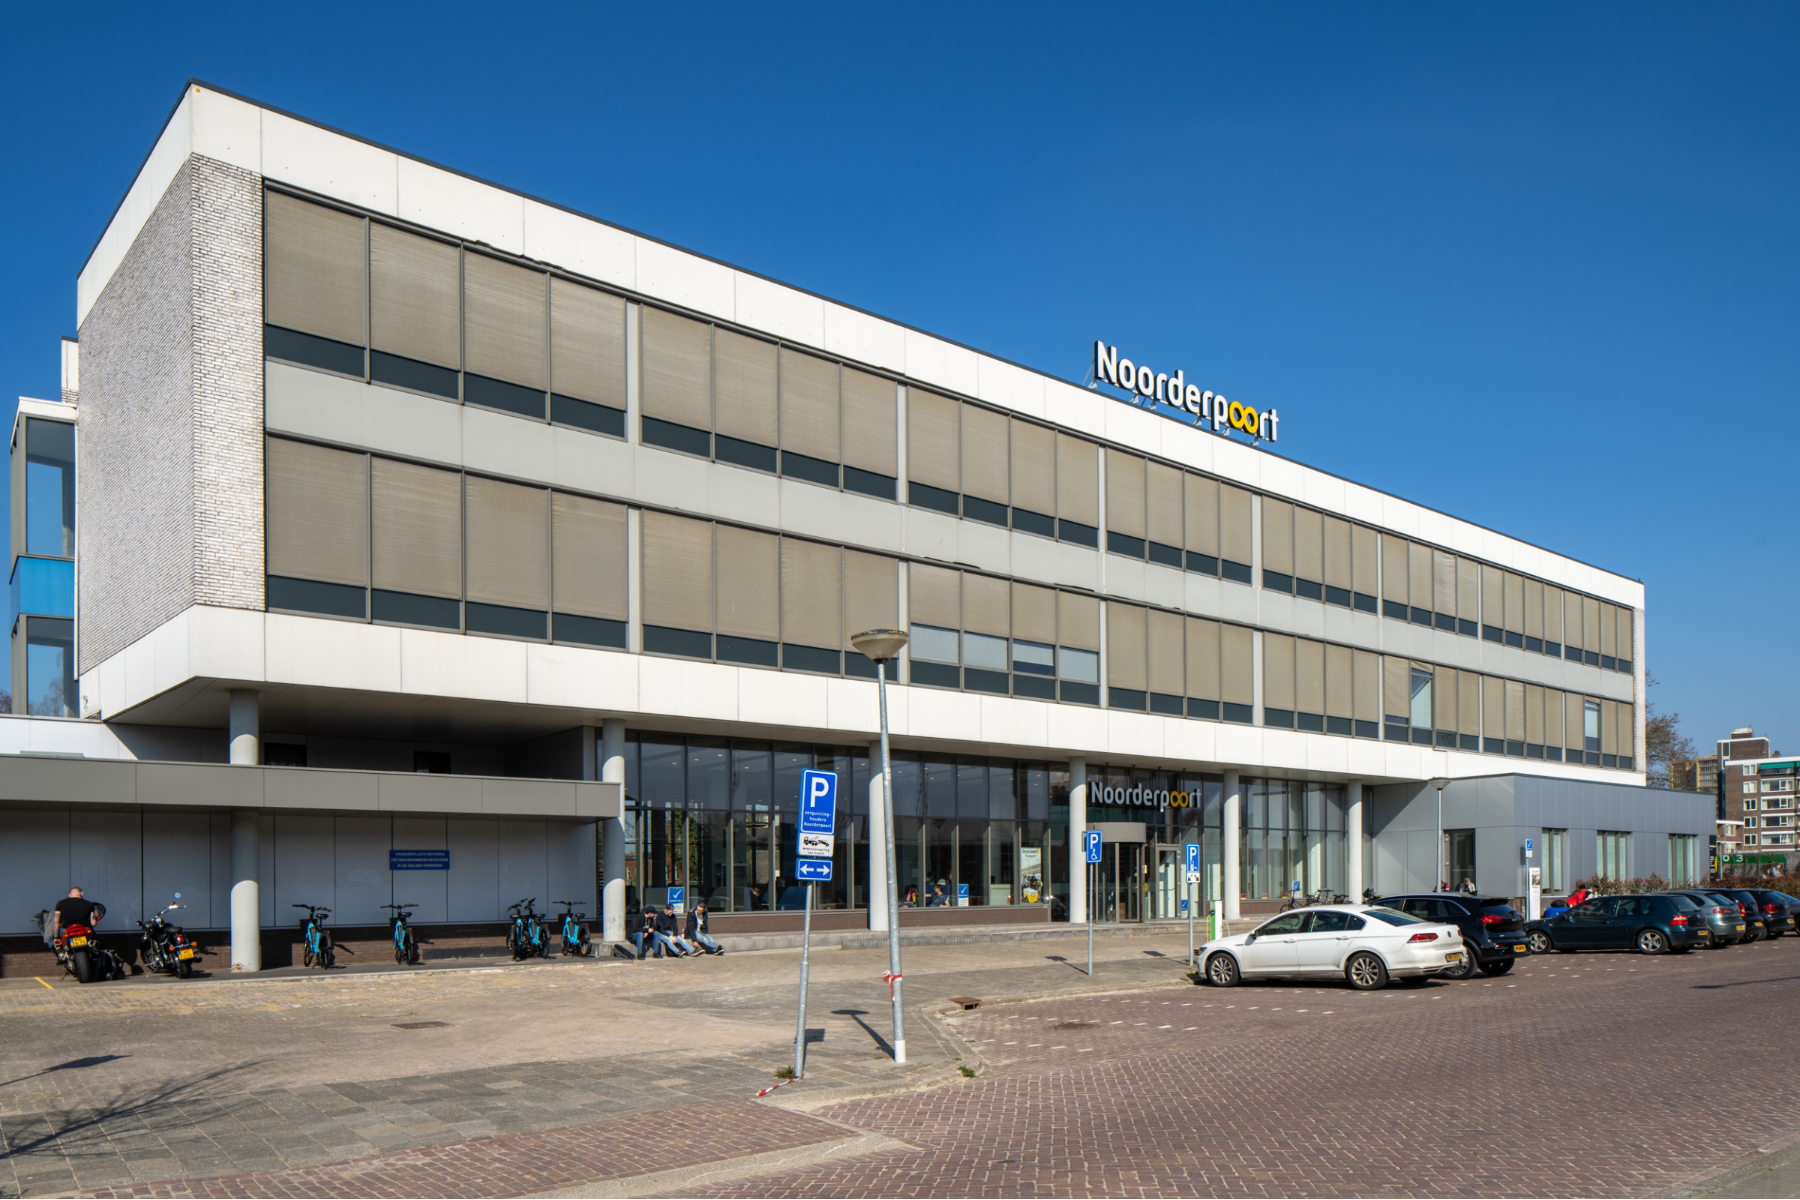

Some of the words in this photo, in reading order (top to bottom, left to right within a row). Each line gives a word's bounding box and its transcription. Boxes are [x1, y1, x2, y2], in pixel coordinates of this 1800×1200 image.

[1094, 340, 1279, 443] Noorderpoort
[810, 776, 829, 808] P
[1090, 781, 1201, 813] Noorderpoort
[1090, 833, 1099, 850] P
[1189, 846, 1197, 861] P
